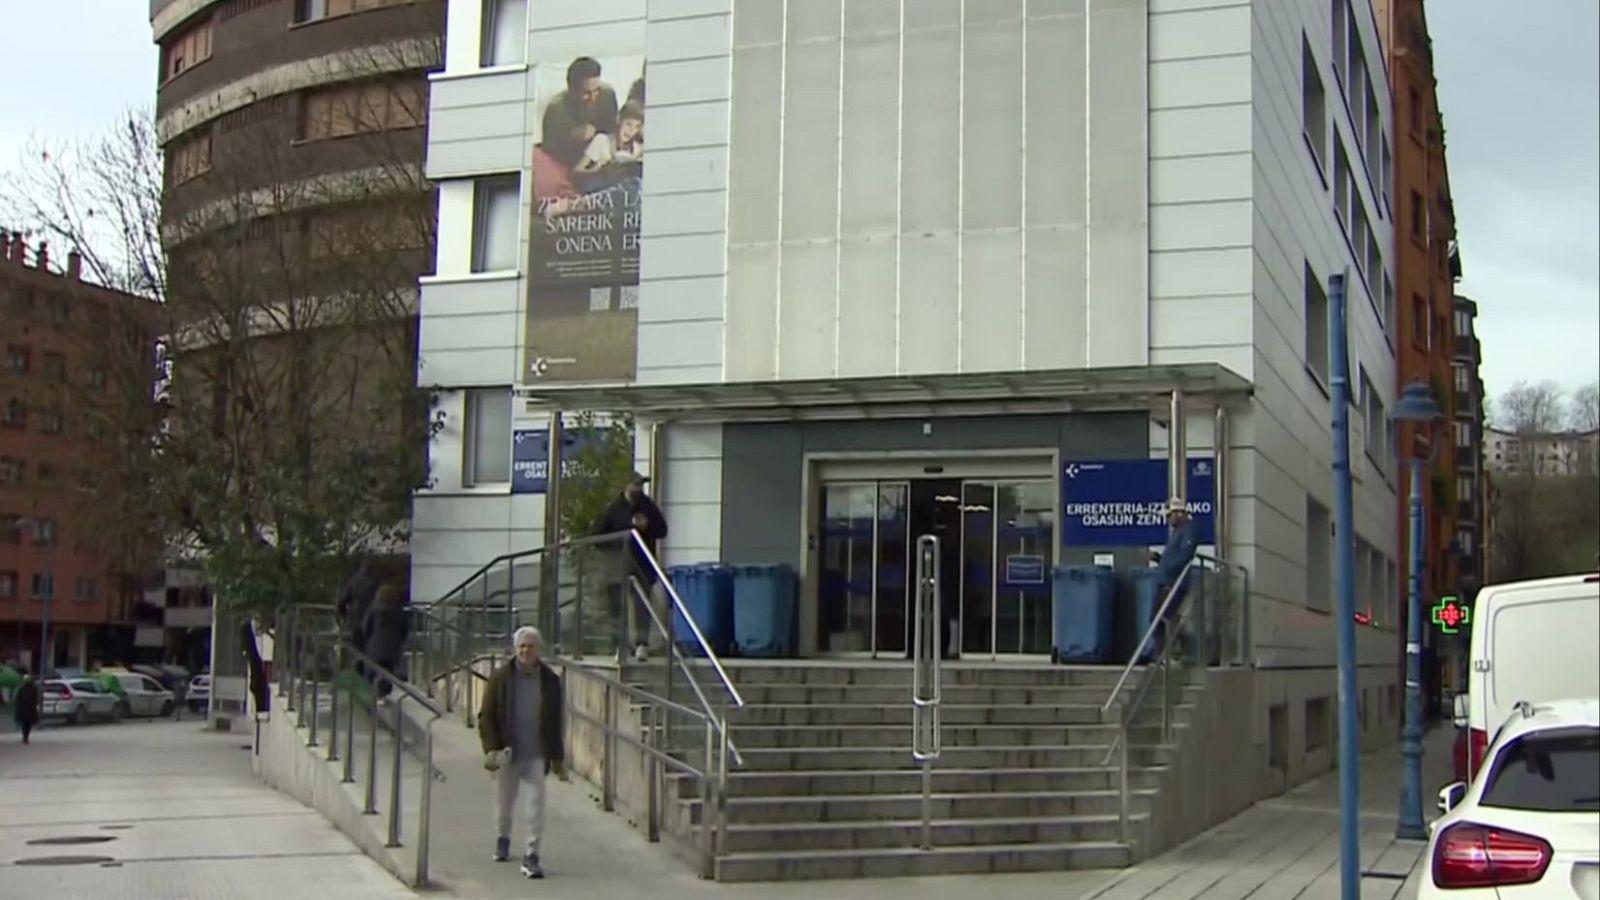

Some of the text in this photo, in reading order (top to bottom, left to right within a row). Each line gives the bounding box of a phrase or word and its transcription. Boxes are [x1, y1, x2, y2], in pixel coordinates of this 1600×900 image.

[571, 190, 614, 211] ZARA
[546, 213, 613, 234] SARERIK
[556, 235, 612, 254] ONENA
[1082, 514, 1133, 526] OSASUN
